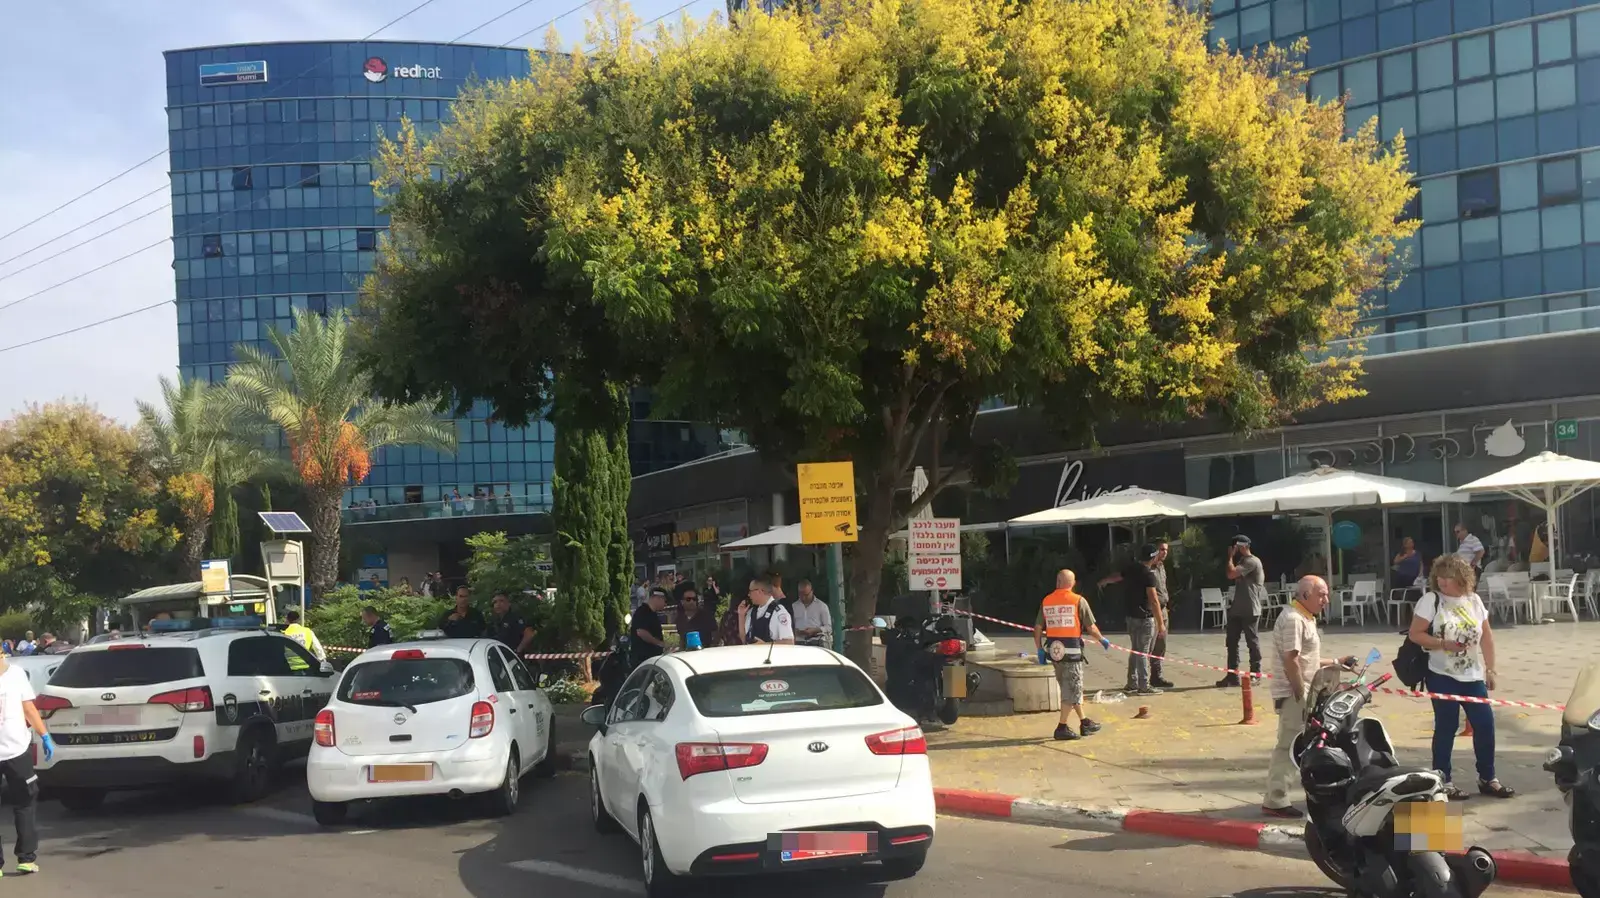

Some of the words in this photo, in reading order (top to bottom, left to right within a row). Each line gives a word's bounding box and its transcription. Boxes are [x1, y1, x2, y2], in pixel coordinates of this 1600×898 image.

[394, 64, 442, 79] redhat
[1558, 424, 1577, 436] 34
[913, 521, 932, 529] לרכב
[913, 531, 935, 539] בלבד!
[941, 557, 953, 565] אין
[911, 567, 942, 576] לאופנועים
[68, 735, 105, 744] ישראל
[113, 732, 157, 743] משטרת
[809, 742, 828, 752] KIA
